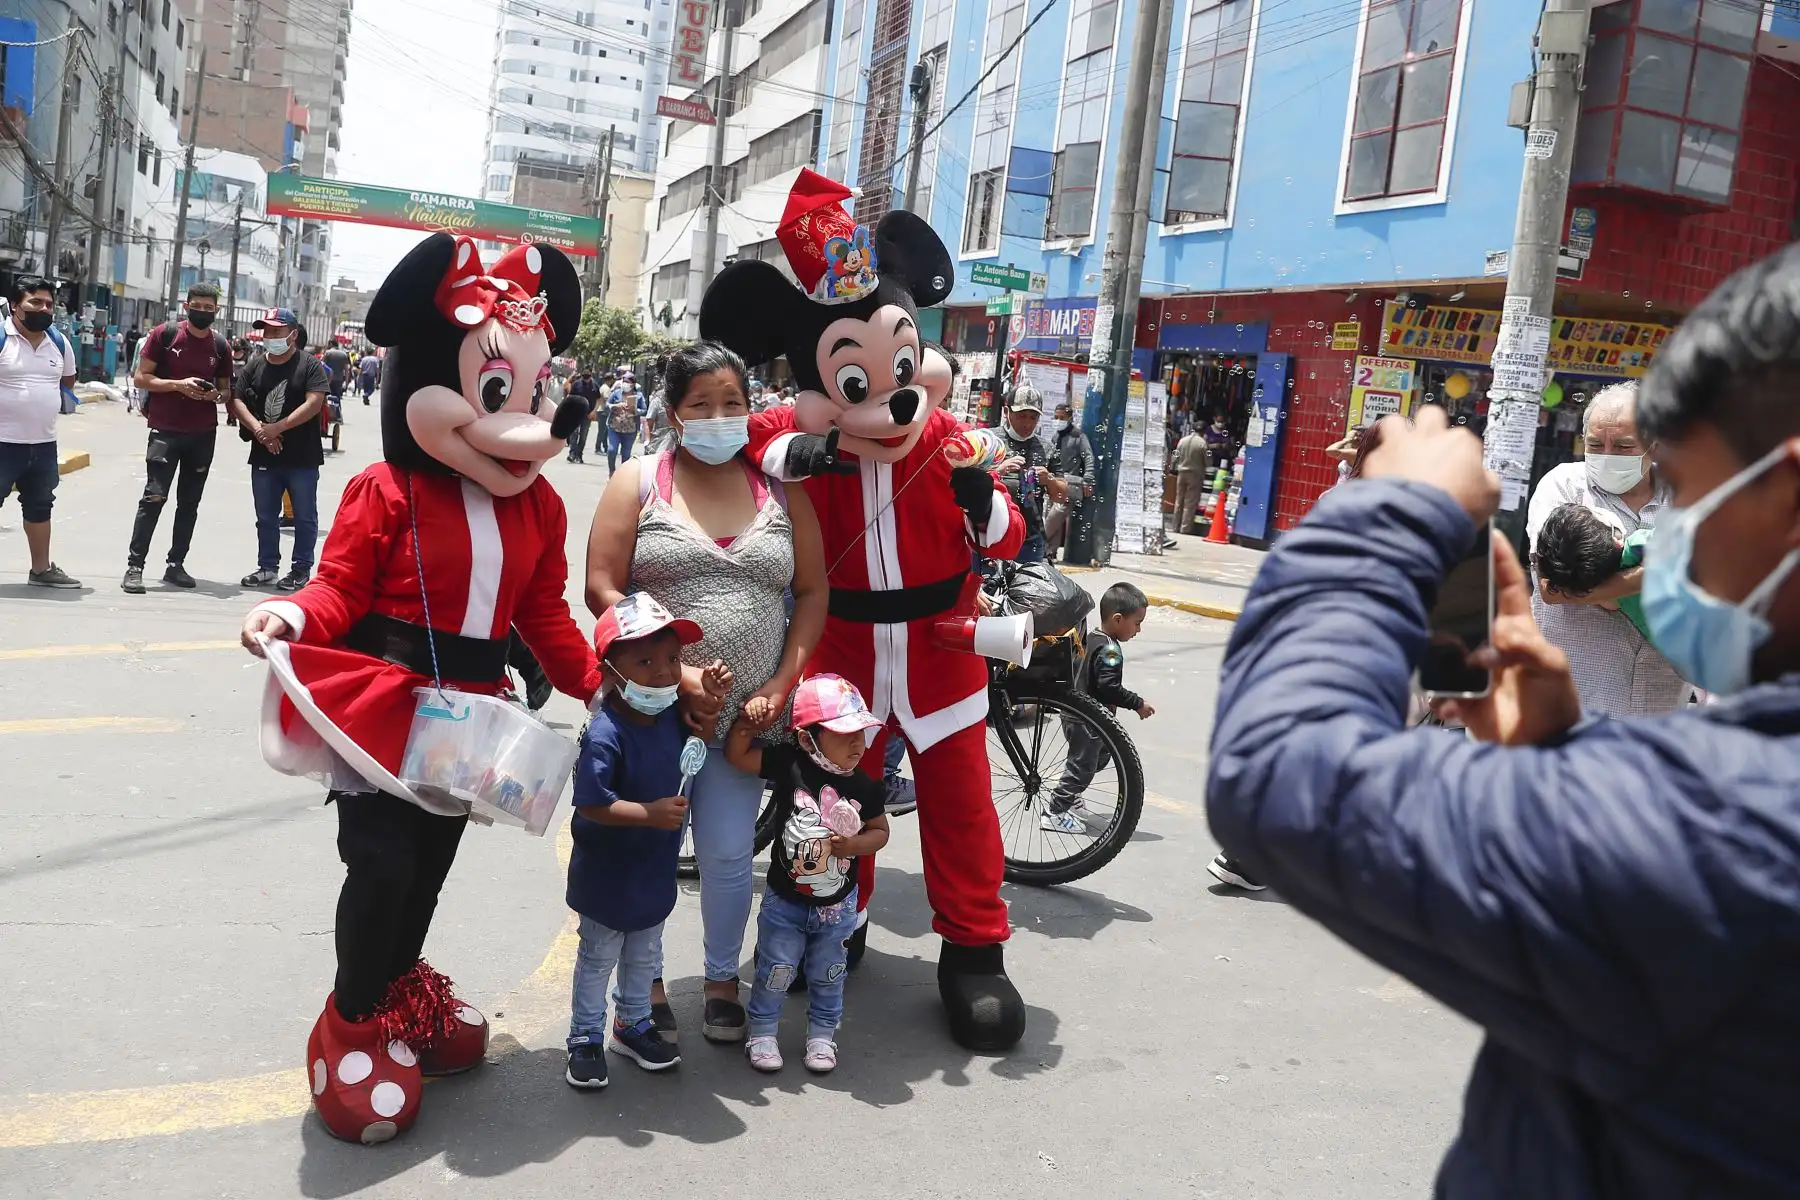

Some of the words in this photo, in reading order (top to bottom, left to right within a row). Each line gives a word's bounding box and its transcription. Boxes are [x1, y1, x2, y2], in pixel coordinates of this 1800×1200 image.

[665, 101, 696, 118] BARRANCA
[294, 190, 321, 200] Concurso
[303, 184, 349, 197] PARTICIPA
[331, 200, 359, 210] TIENDAS
[410, 191, 476, 211] GAMARRA
[299, 203, 325, 211] PUERTA
[331, 206, 352, 214] CALLE
[404, 202, 477, 230] Navidad
[974, 264, 983, 272] Jr.
[983, 265, 1009, 277] Antonio
[1009, 269, 1025, 280] Bazo
[1360, 357, 1411, 370] OFERTAS
[1505, 352, 1539, 362] NECESITA
[1567, 362, 1625, 375] ACCESORIOS
[1357, 367, 1411, 390] 2021
[1369, 395, 1396, 404] MICA
[1364, 404, 1399, 413] VIDRIO
